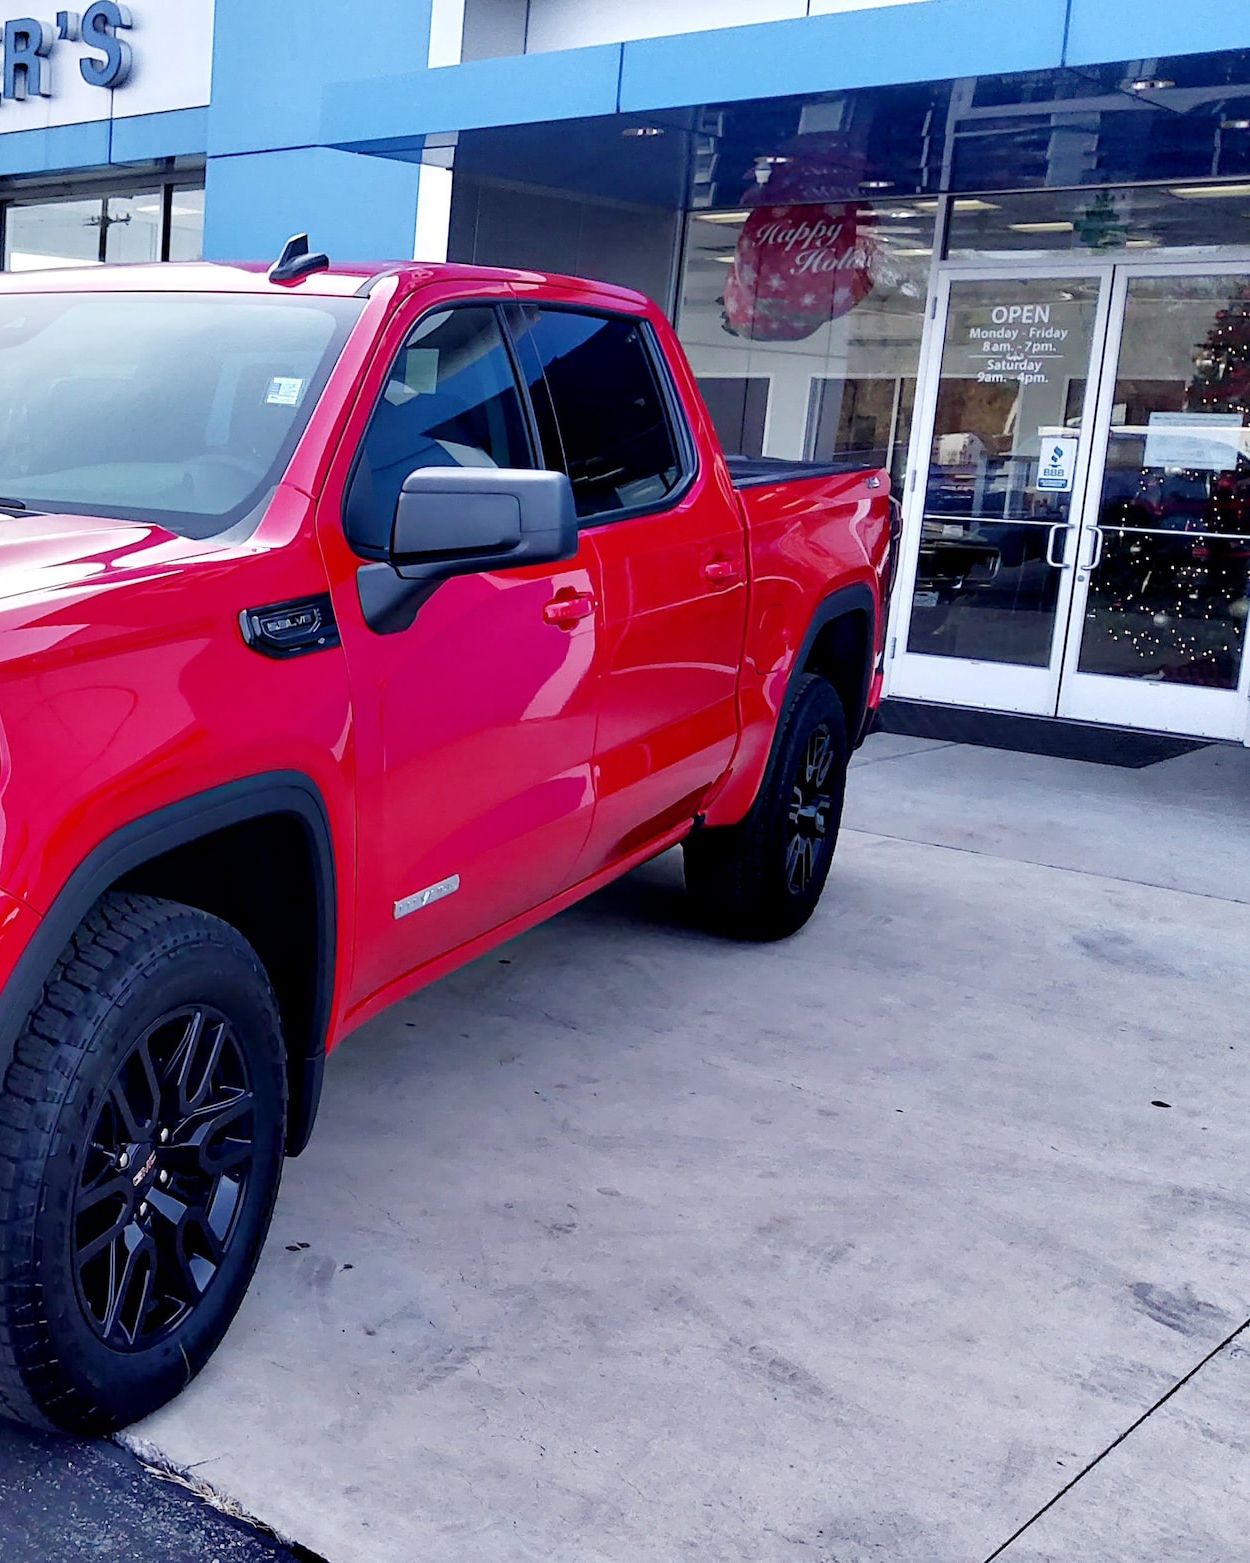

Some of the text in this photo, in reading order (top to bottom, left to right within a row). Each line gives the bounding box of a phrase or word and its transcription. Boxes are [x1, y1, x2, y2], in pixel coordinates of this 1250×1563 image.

[752, 220, 843, 251] Happy
[991, 304, 1050, 324] OPEN
[969, 327, 1019, 340] Monday
[1029, 327, 1068, 341] Friday
[1025, 341, 1056, 353] 7pm.
[987, 359, 1042, 372] Saturday
[977, 372, 1007, 383] 9am.
[1017, 372, 1048, 384] 4pm.
